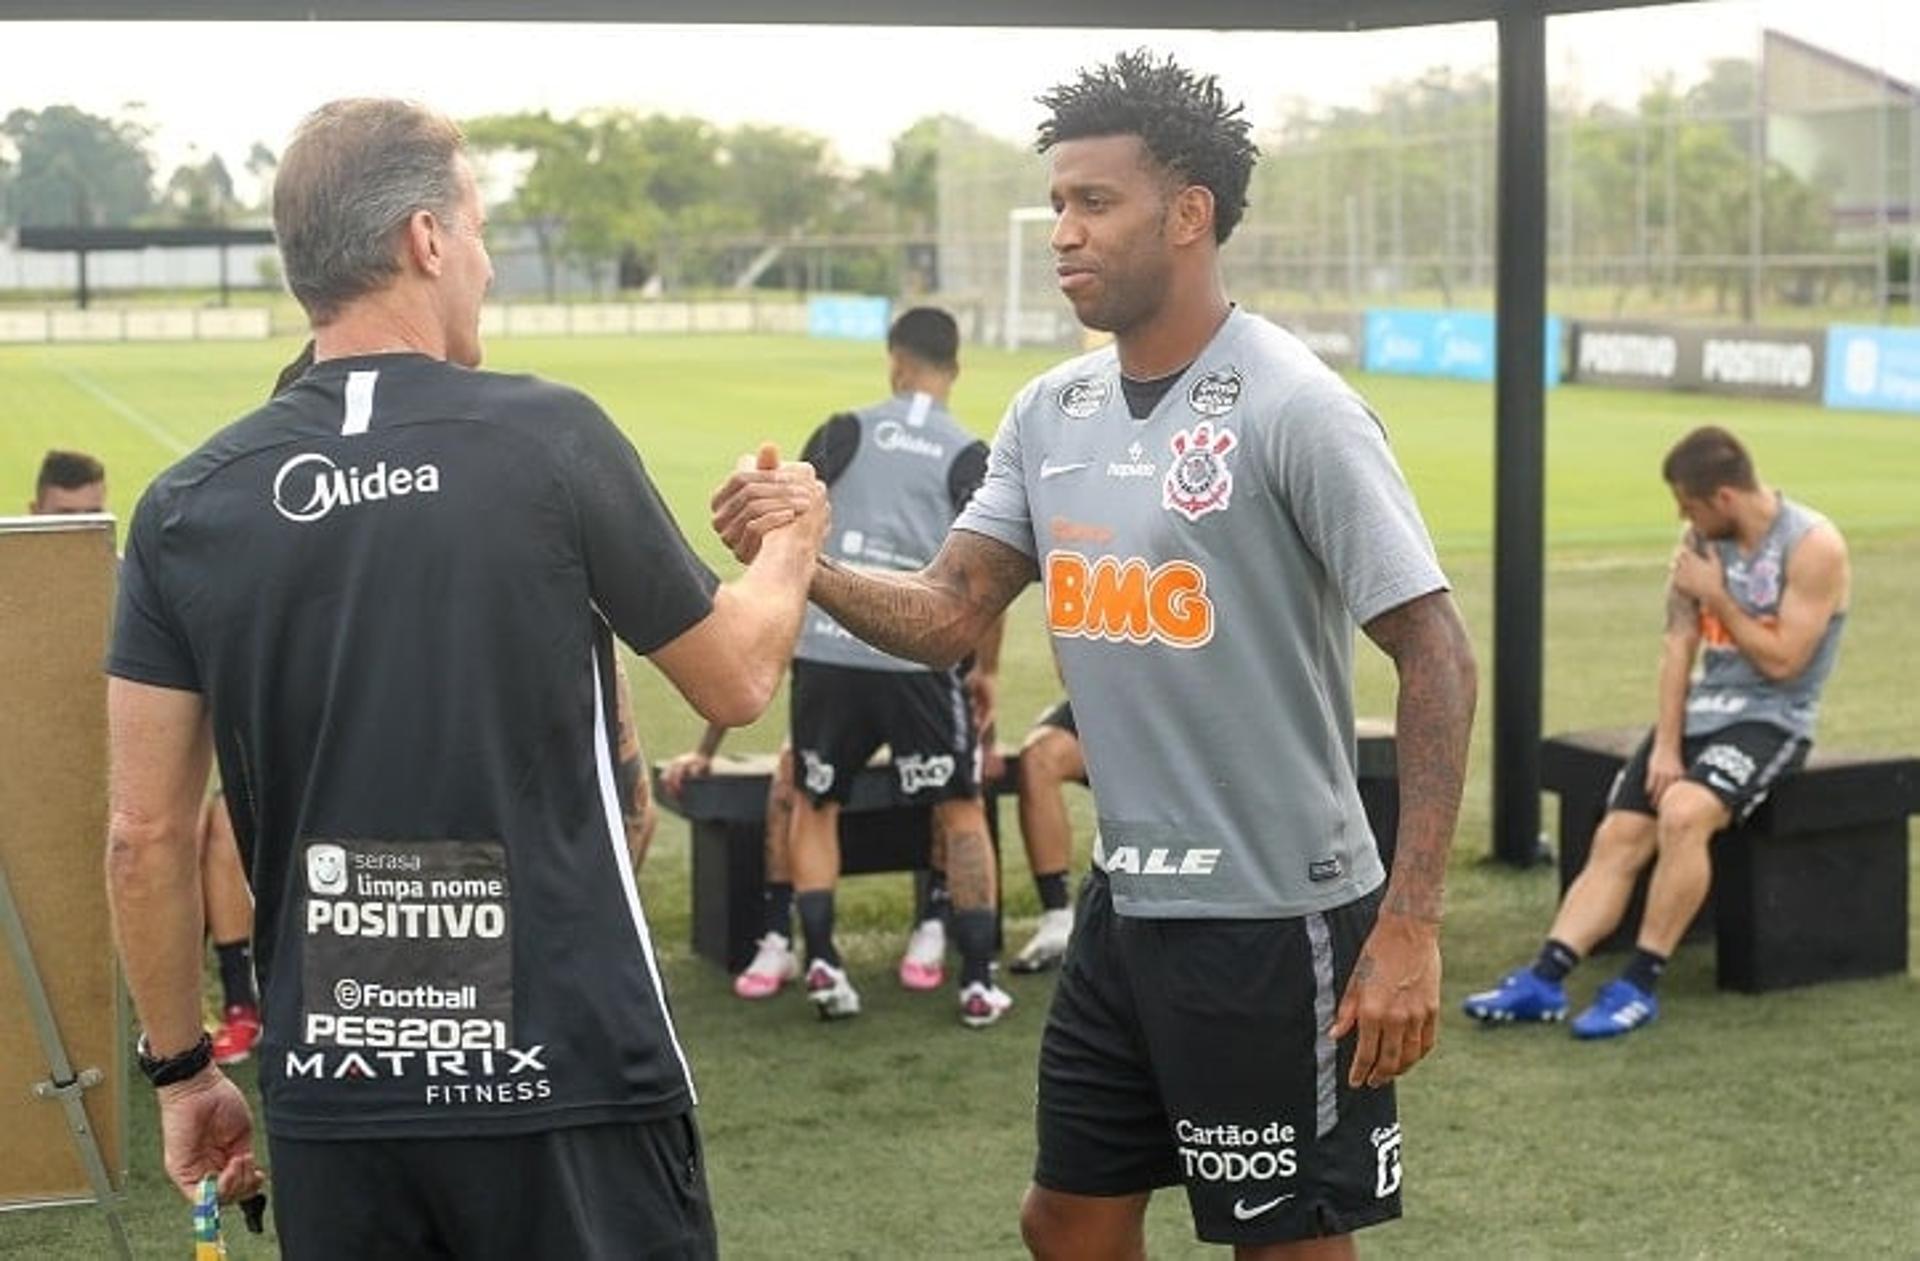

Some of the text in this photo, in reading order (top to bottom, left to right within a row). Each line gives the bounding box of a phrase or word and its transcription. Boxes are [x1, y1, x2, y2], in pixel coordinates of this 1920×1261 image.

[272, 452, 440, 522] Midea
[1045, 549, 1215, 649] BMG
[354, 853, 421, 872] serasa
[357, 873, 504, 901] limpa nome
[306, 900, 506, 938] POSITIVO
[305, 1013, 507, 1050] PES2021
[285, 1045, 547, 1079] MATRIX
[426, 1080, 551, 1104] FITNESS
[1176, 1120, 1296, 1146] Cartão de
[1179, 1147, 1297, 1182] TODOS
